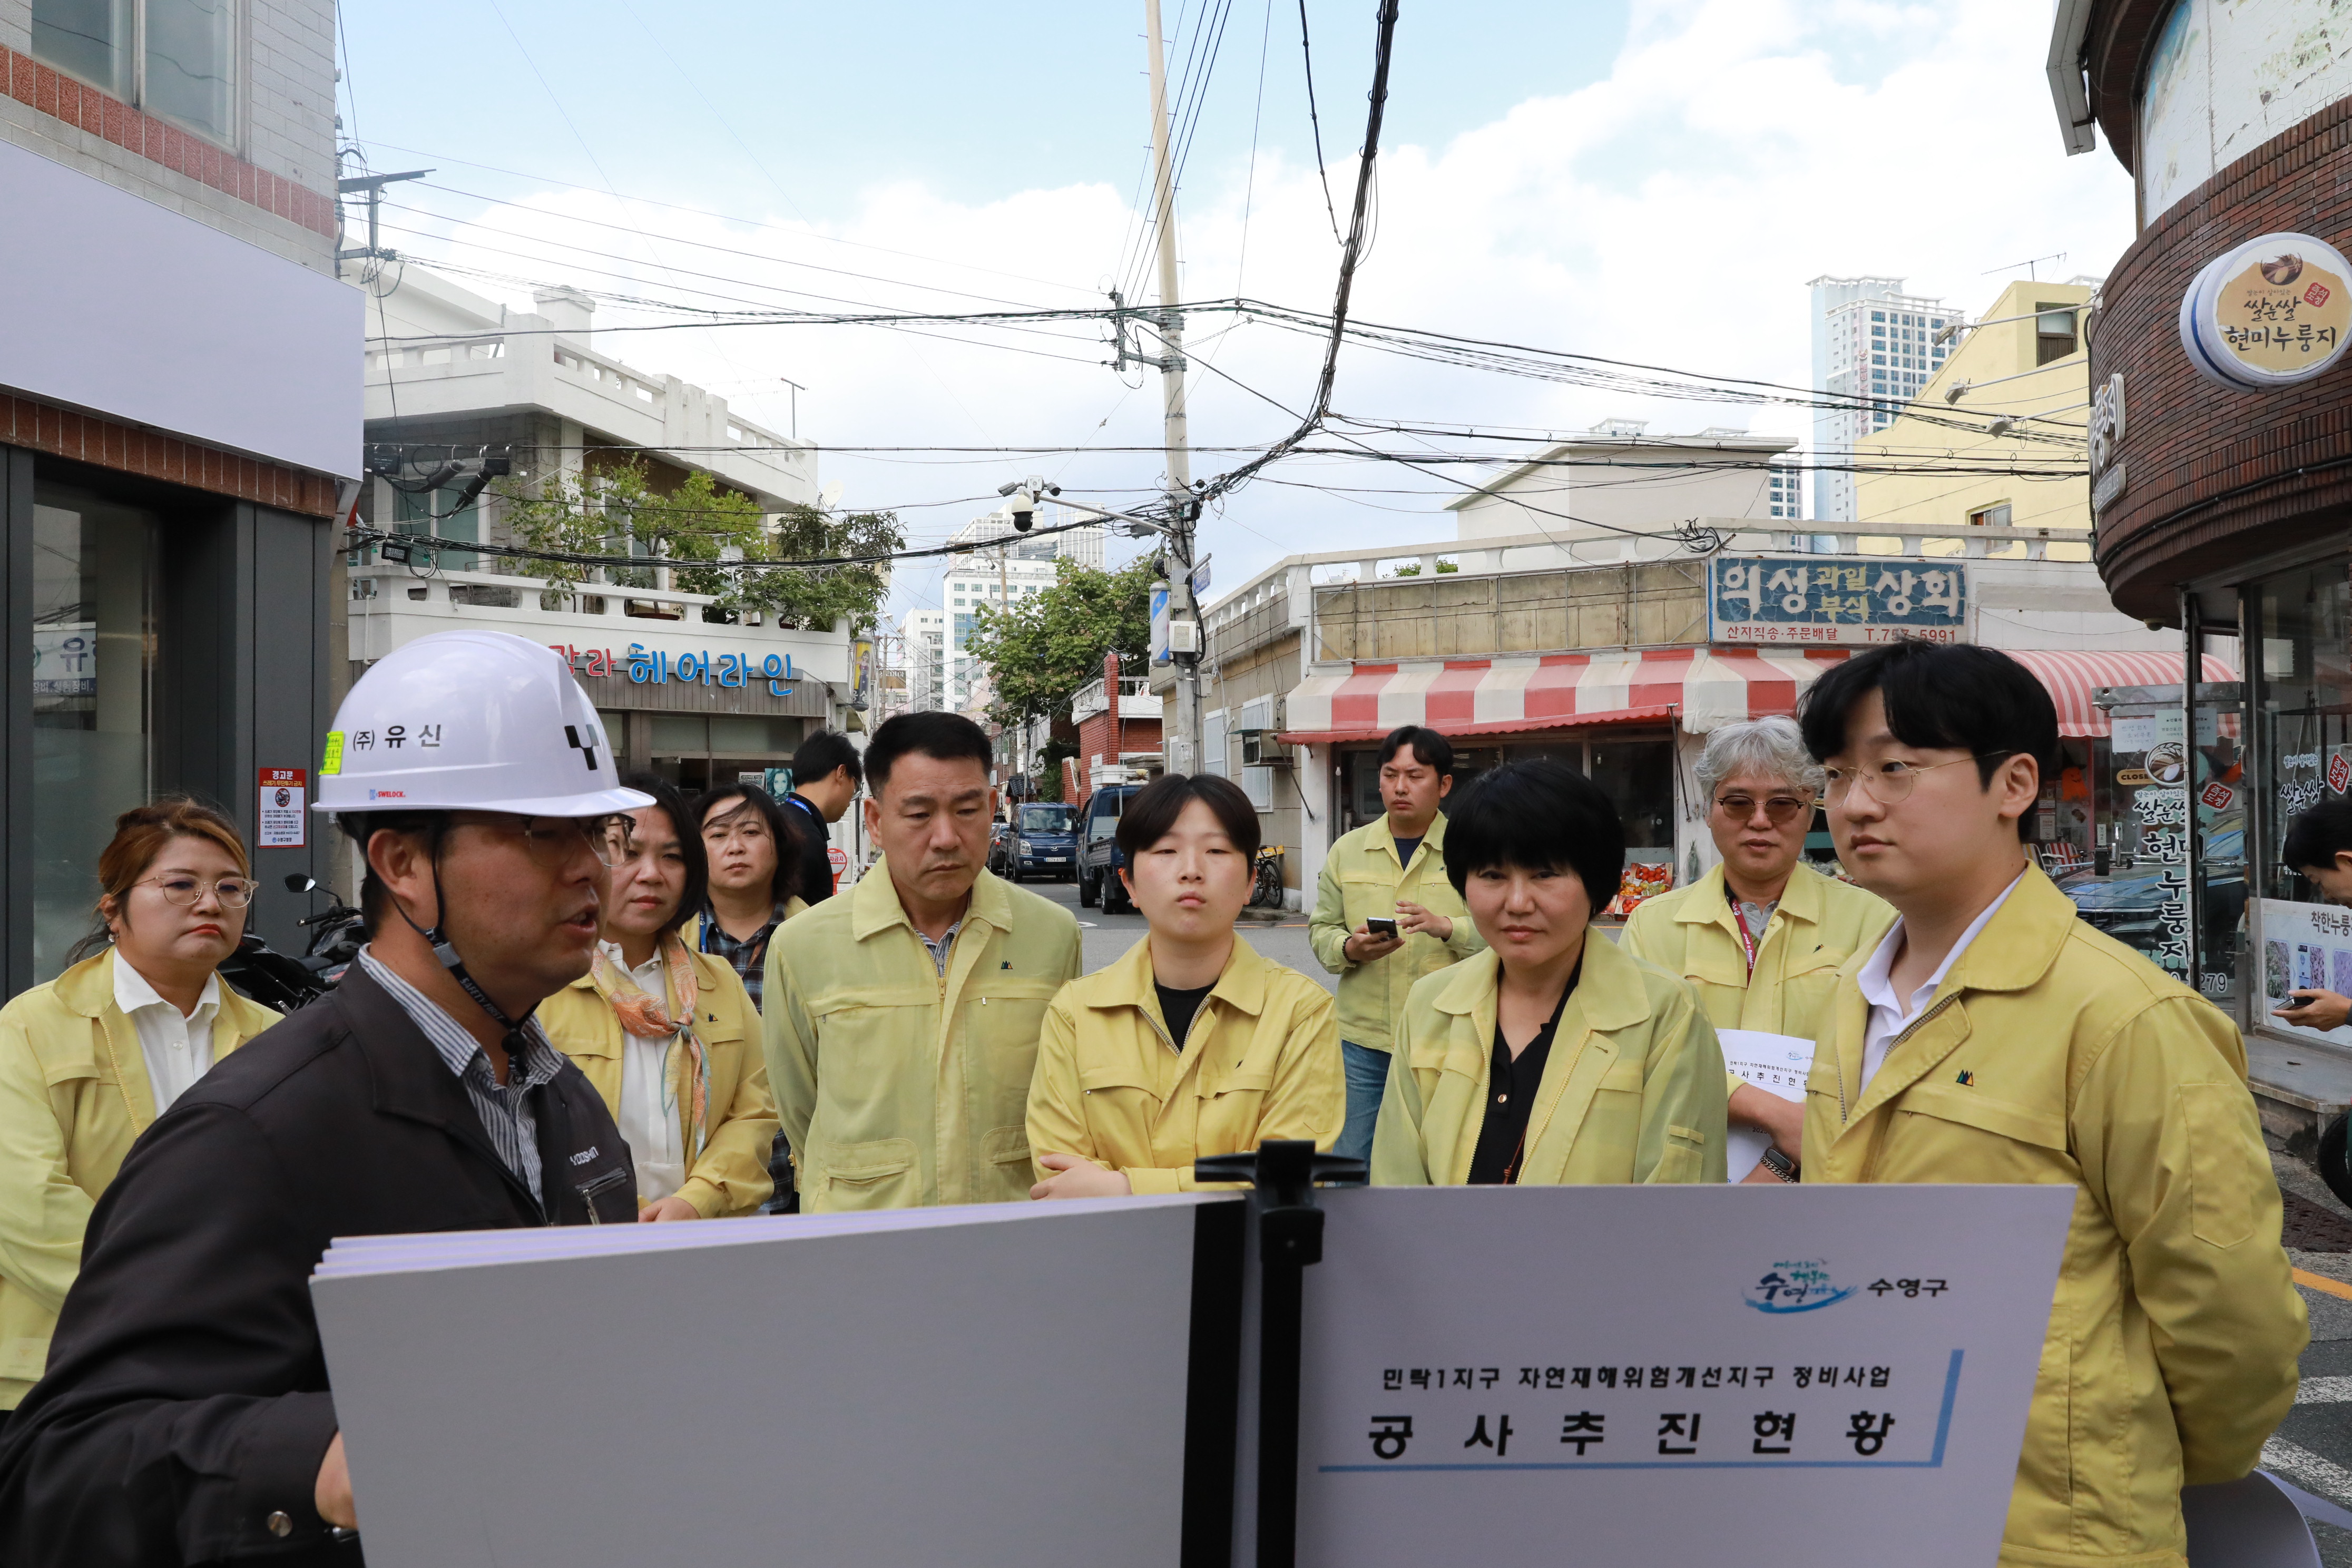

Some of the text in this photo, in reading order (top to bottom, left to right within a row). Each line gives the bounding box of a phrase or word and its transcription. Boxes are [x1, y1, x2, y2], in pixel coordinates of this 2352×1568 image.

[2244, 296, 2302, 321] 쌀눈쌀
[2224, 324, 2336, 352] 현미누룽지
[1721, 565, 1960, 617] 의성 상회
[1814, 566, 1867, 591] 과일
[1817, 595, 1869, 620] 부식
[628, 643, 792, 697] 헤어라인
[272, 771, 293, 780] 경고문
[2311, 911, 2352, 936] 착한누룽
[570, 1146, 599, 1165] YOOSHIN
[1867, 1278, 1948, 1298] 수영구
[1384, 1366, 1890, 1390] 민락1지구 자연재해위험개선지구 정비사업
